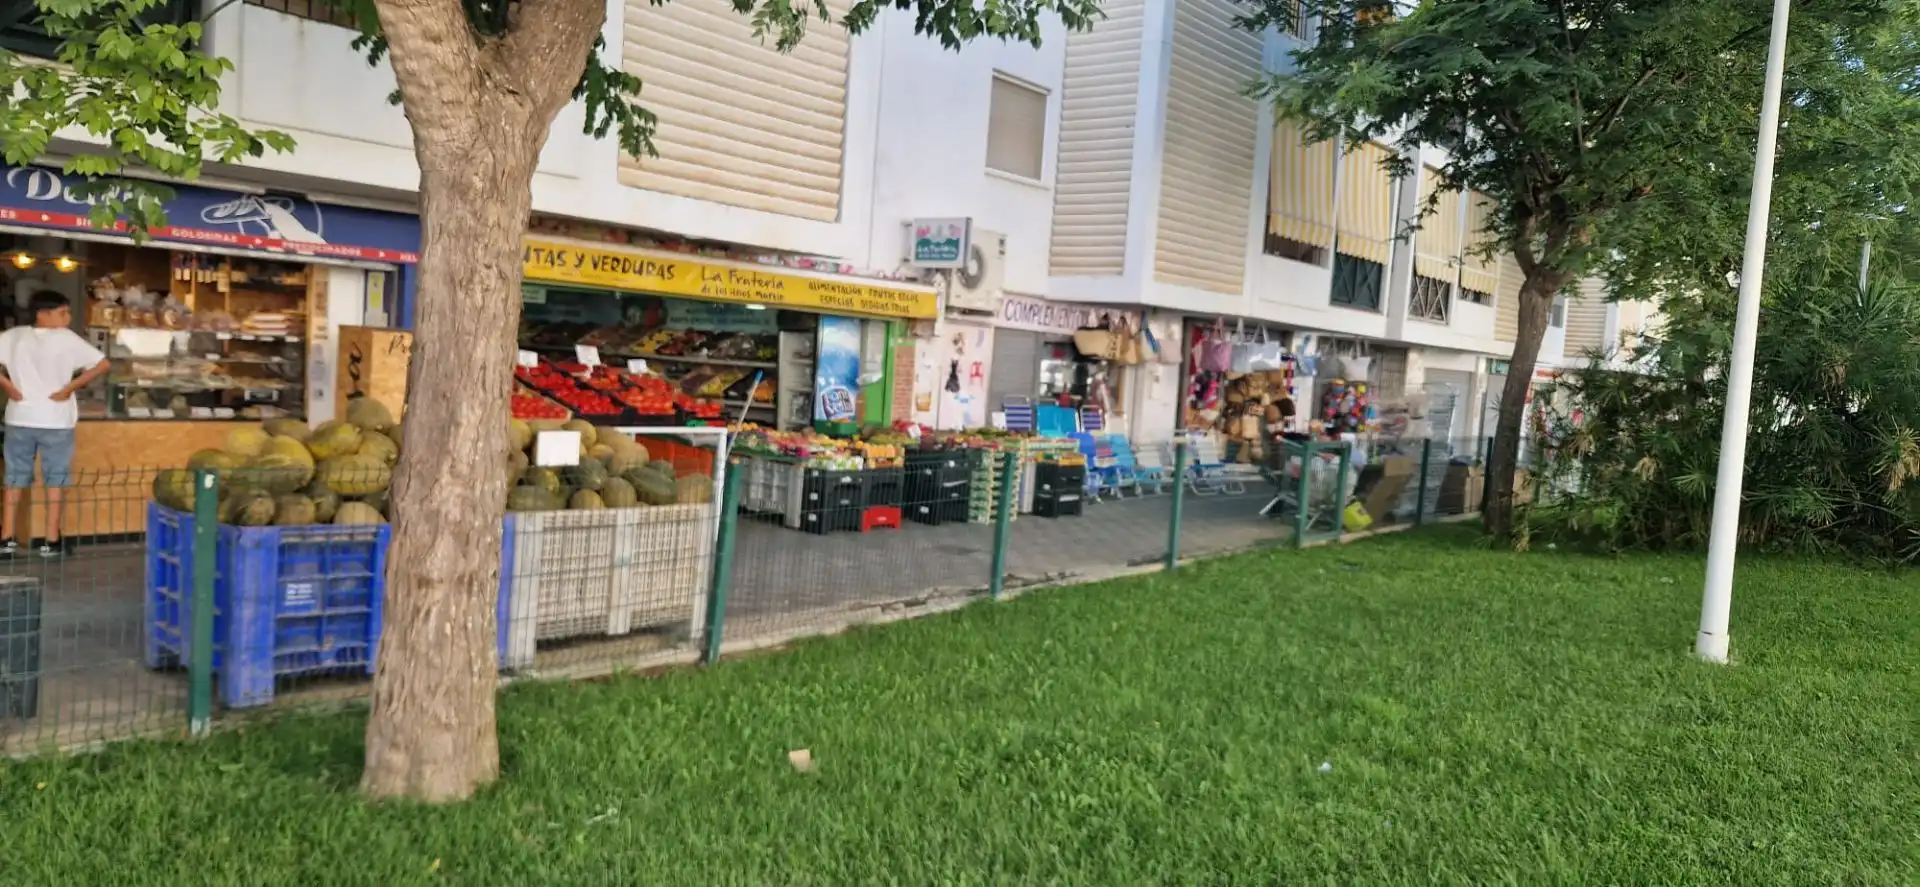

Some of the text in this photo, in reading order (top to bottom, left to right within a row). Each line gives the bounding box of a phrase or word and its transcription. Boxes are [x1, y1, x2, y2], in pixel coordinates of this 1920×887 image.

[574, 252, 585, 268] Y
[591, 253, 676, 281] VERDURAS
[701, 265, 722, 282] La
